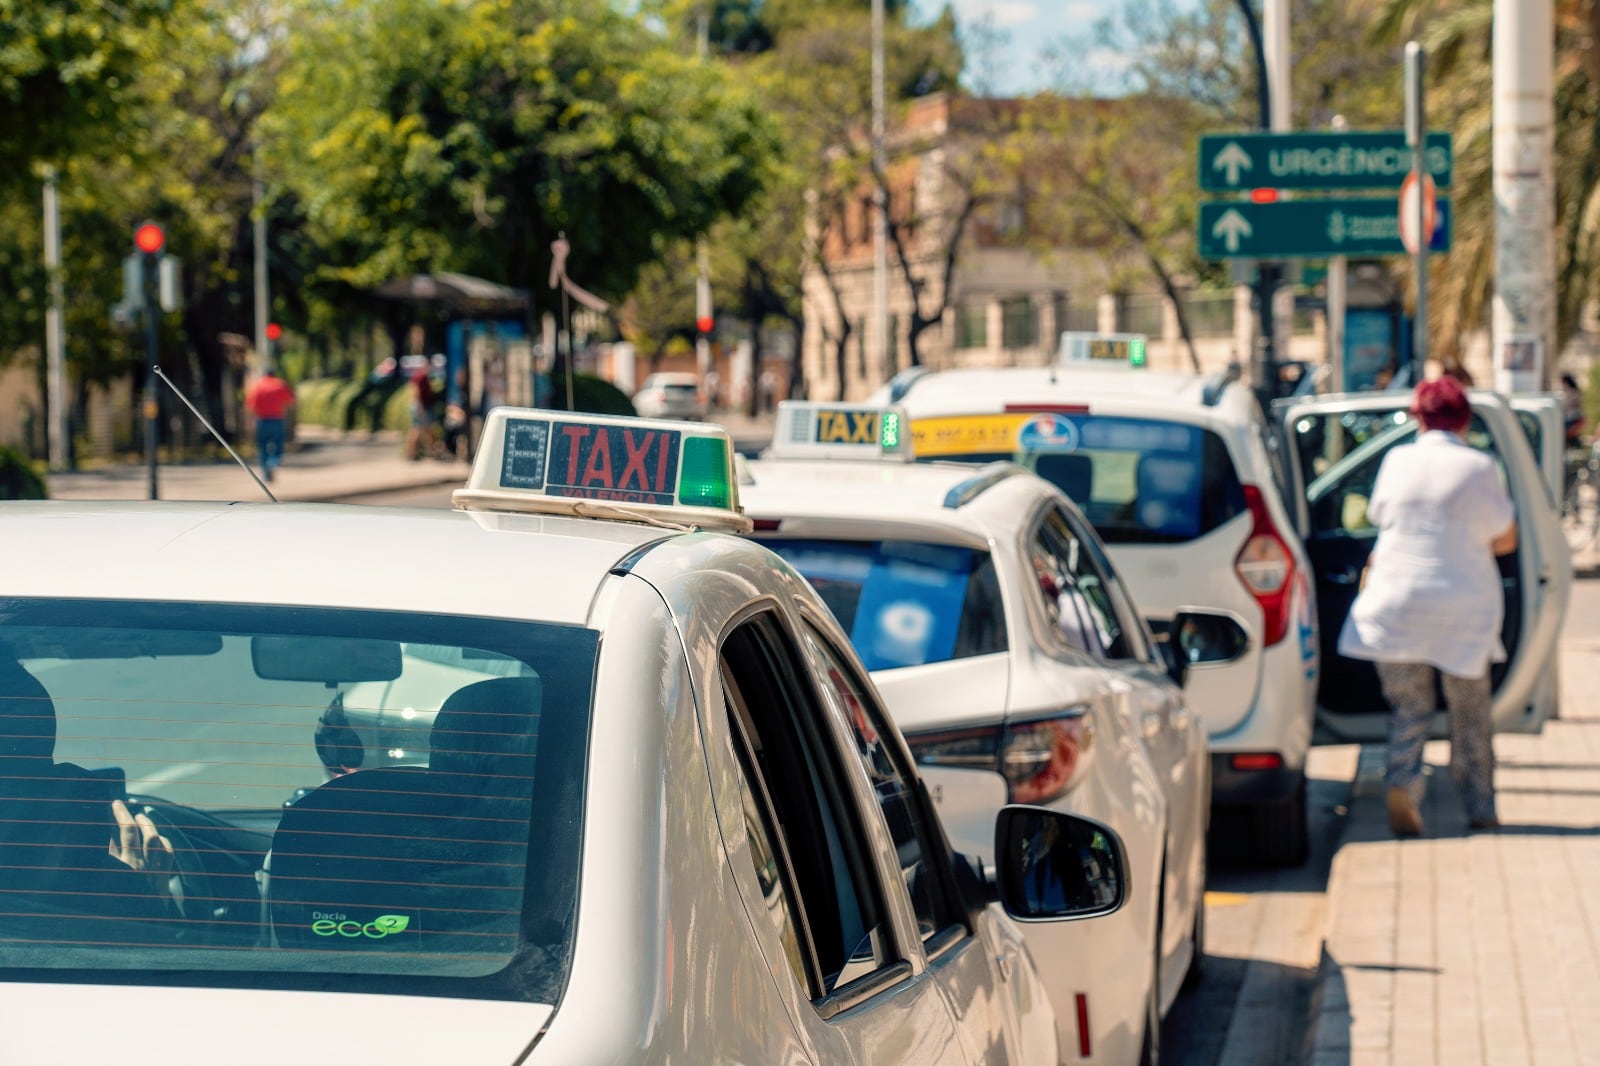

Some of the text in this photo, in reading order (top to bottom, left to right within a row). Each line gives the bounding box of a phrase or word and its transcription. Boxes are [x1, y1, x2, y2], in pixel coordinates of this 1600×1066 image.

[817, 411, 878, 442] TAXI
[562, 426, 670, 492] TAXI
[312, 911, 346, 921] Dacia
